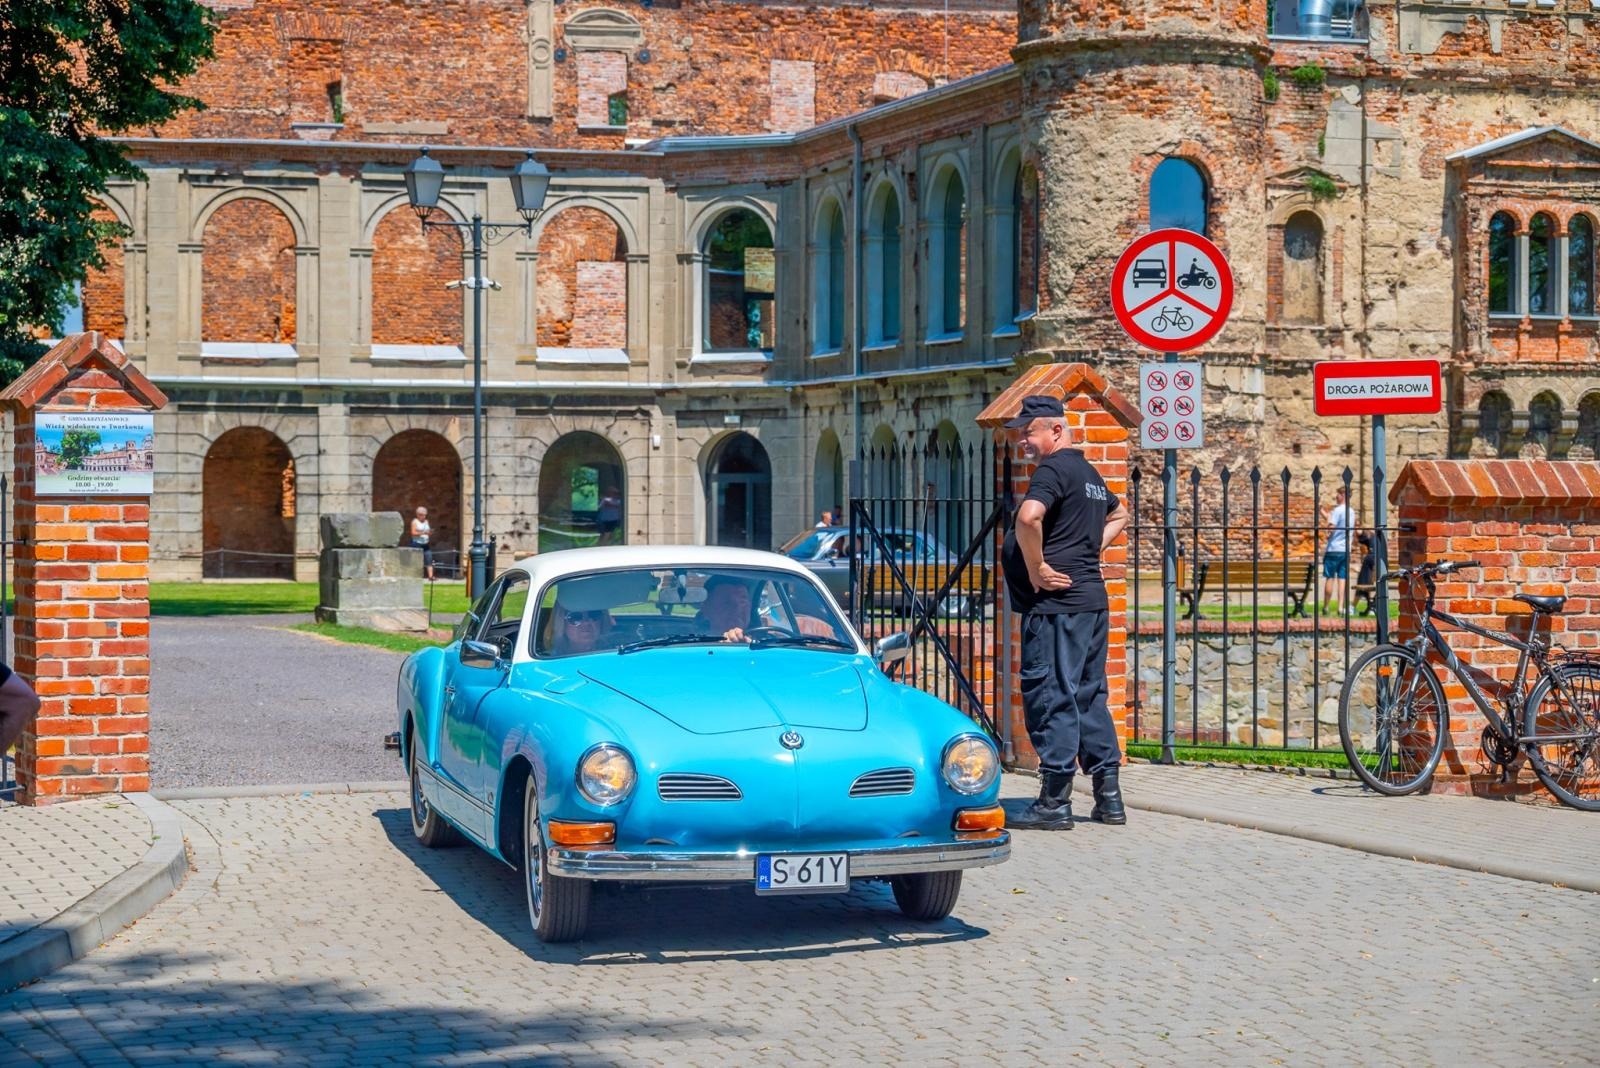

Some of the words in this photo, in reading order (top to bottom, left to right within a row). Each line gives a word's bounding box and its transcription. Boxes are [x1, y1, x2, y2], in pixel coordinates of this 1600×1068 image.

[1327, 385, 1366, 395] DROGA
[1370, 382, 1429, 393] POŻAROWA
[760, 875, 769, 883] PL
[797, 856, 844, 883] 61Y
